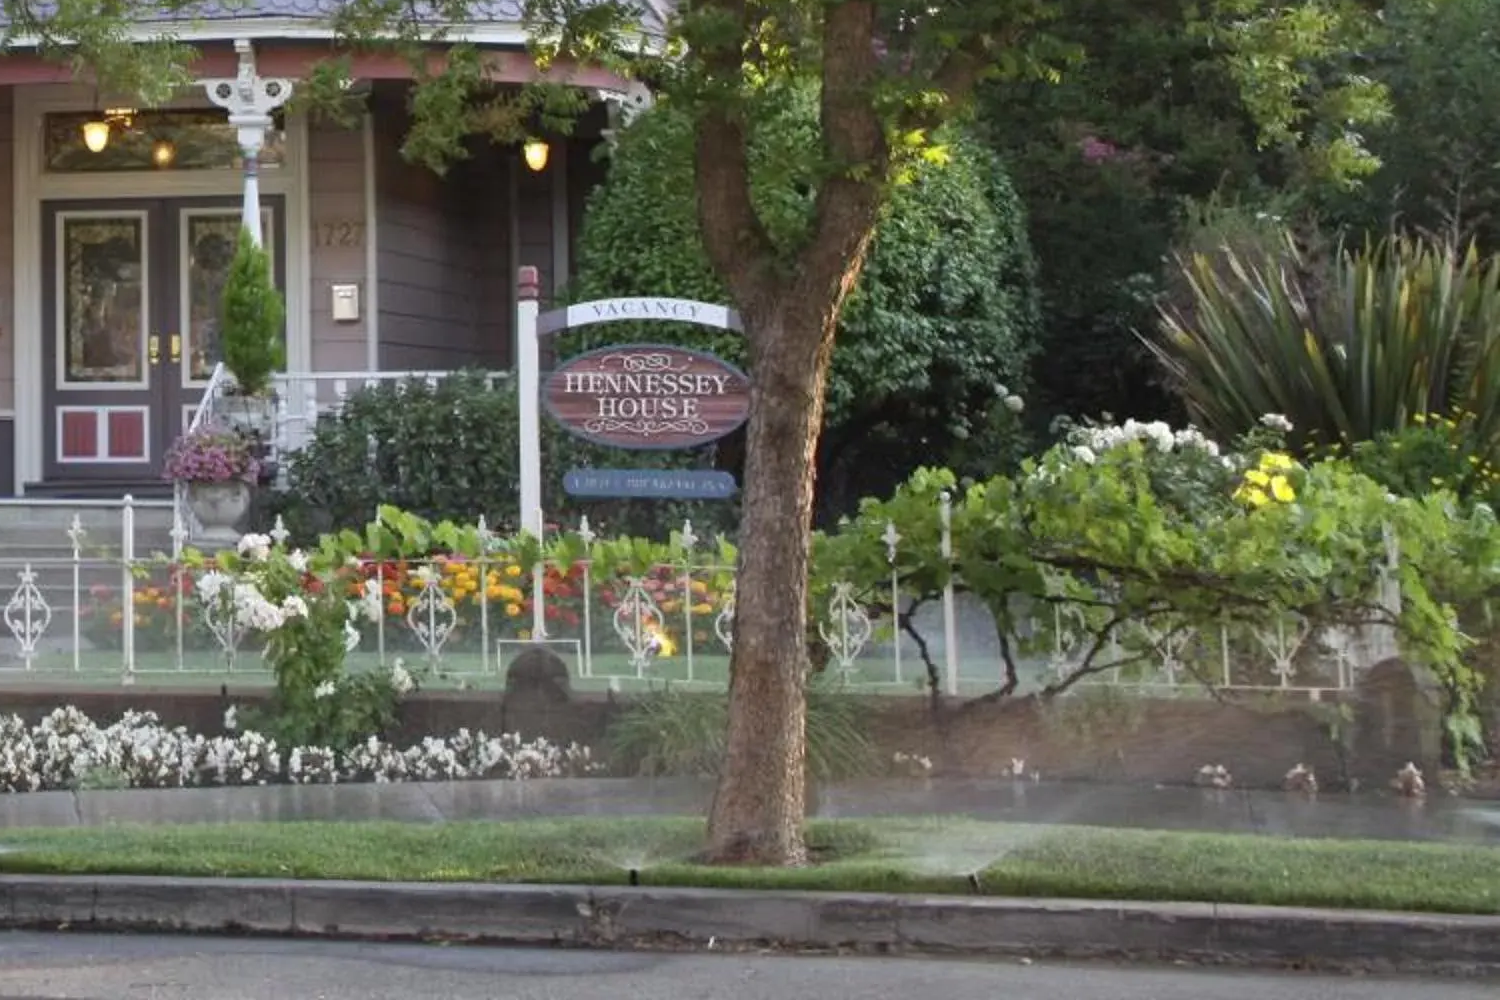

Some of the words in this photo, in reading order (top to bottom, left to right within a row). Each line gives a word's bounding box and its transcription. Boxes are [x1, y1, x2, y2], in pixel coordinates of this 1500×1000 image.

[592, 300, 701, 318] VACANCY
[563, 371, 731, 395] HENNESSEY
[596, 397, 700, 418] HOUSE
